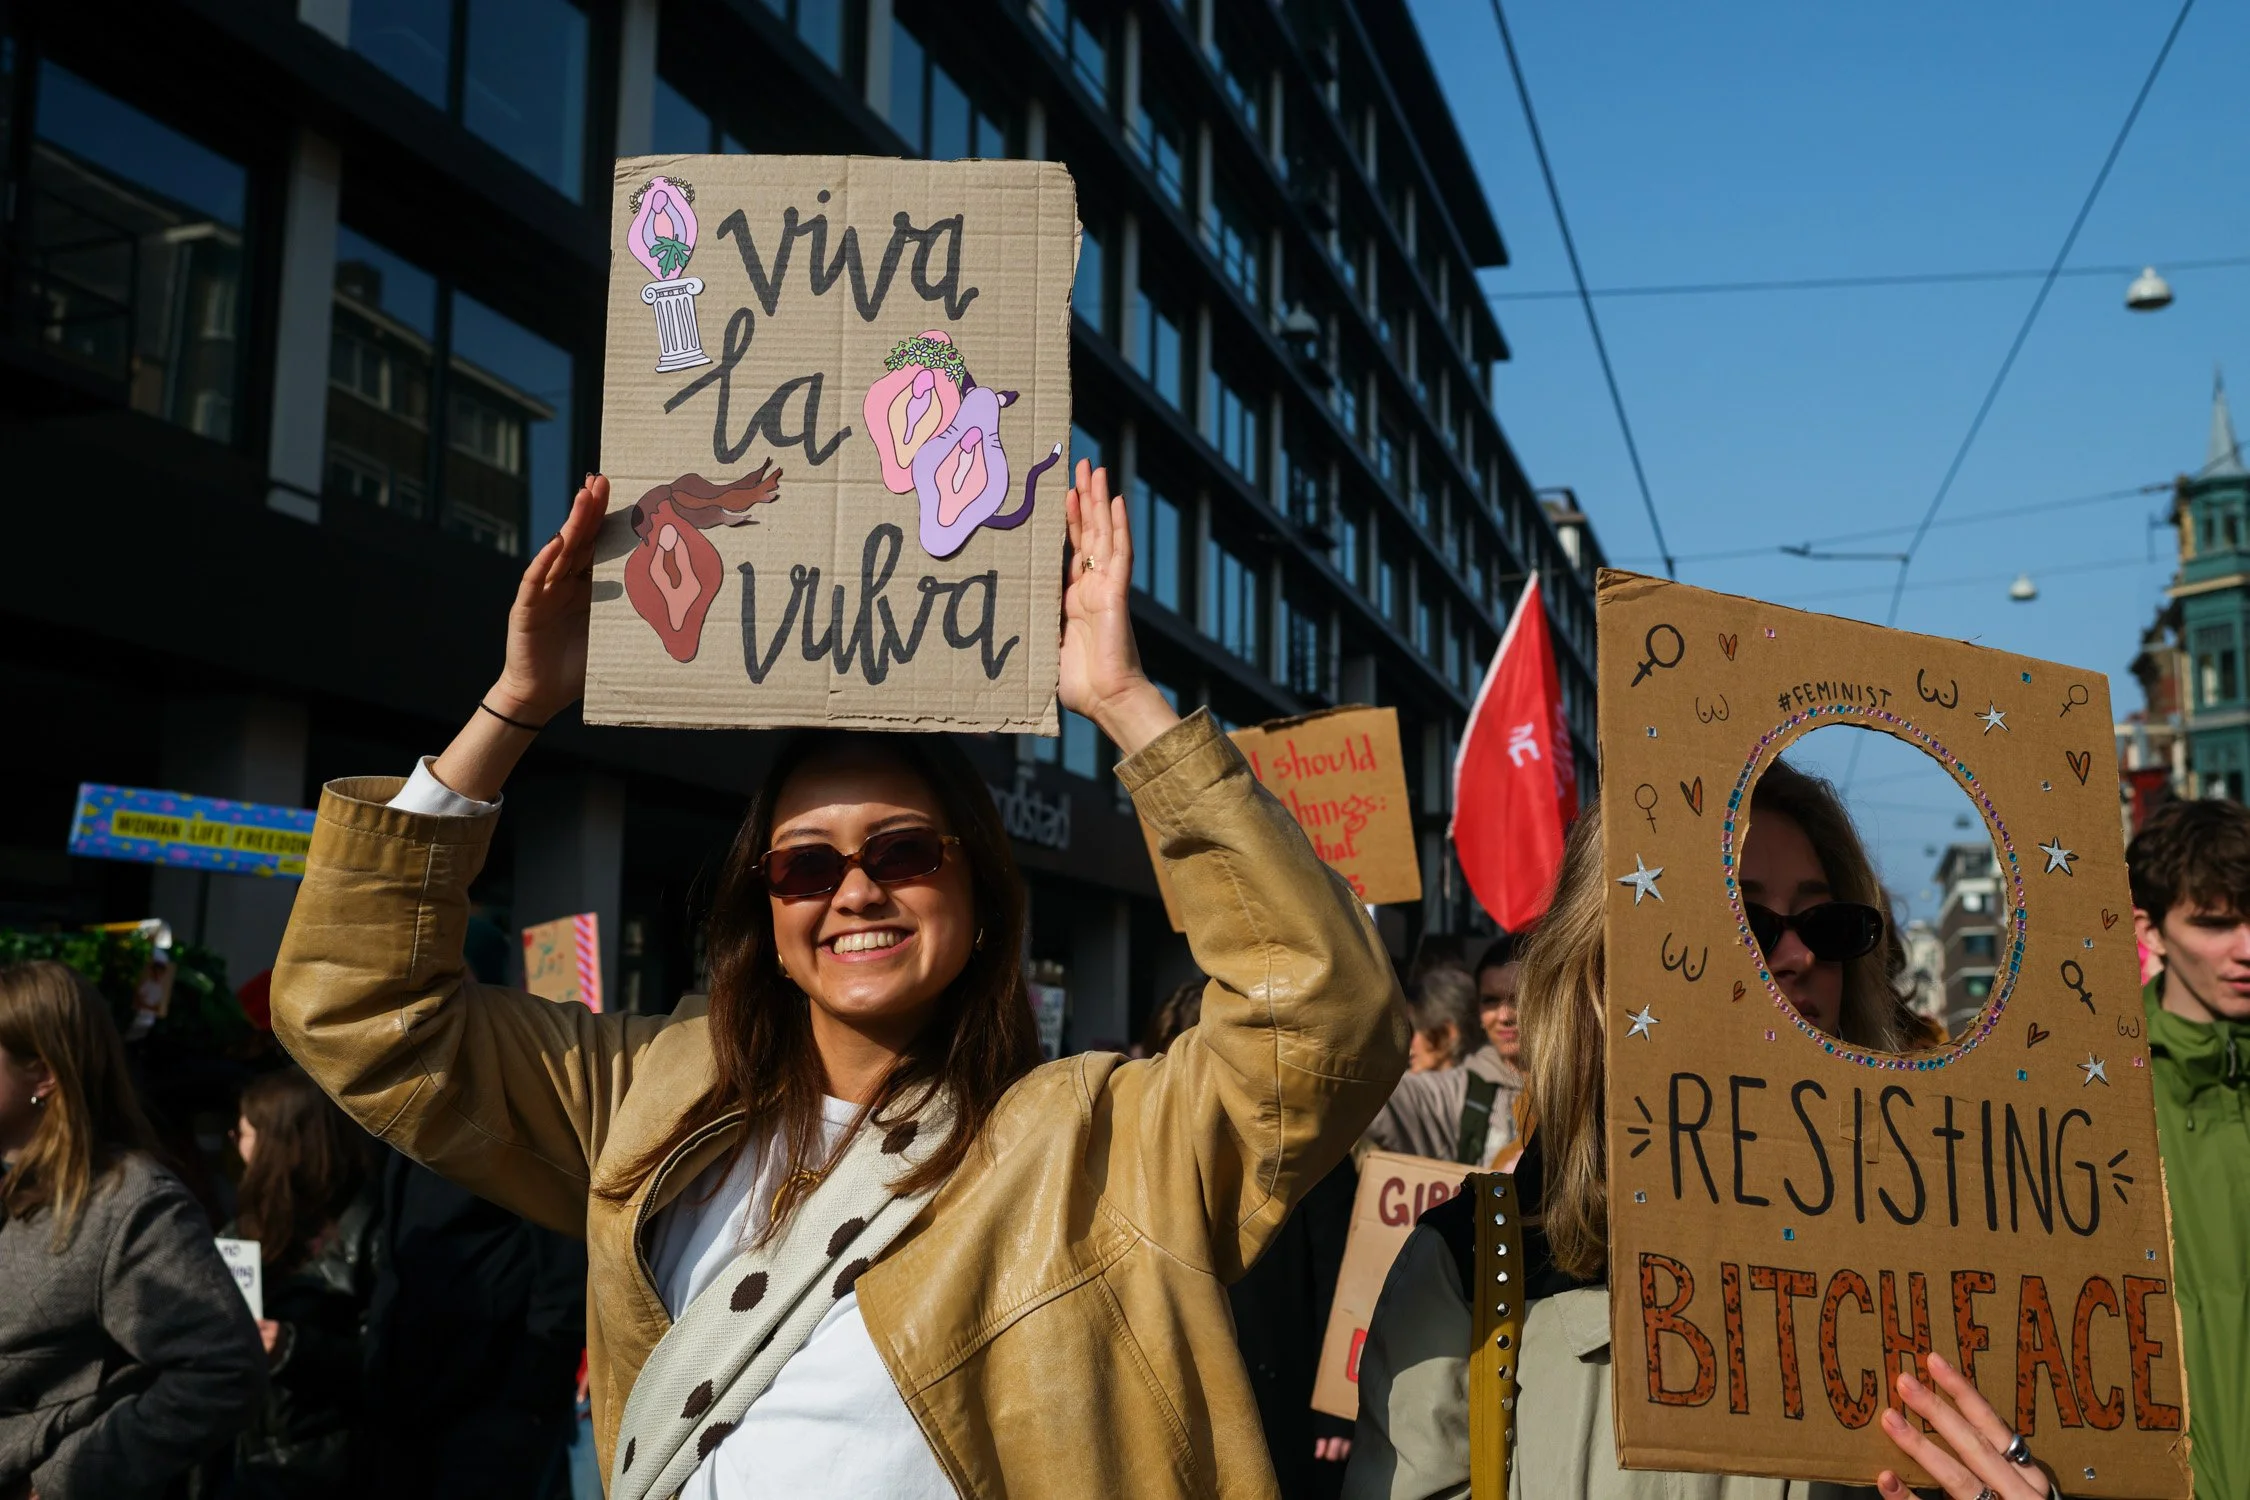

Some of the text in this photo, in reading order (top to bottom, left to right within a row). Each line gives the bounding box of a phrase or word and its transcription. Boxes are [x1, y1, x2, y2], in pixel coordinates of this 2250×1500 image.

[717, 190, 979, 322] viva
[663, 307, 852, 466] la
[1778, 681, 1892, 712] #FEMINIST
[1272, 733, 1377, 781] should
[117, 815, 181, 838] WOMAN
[189, 821, 225, 846] LIFE
[1281, 789, 1387, 834] hings:
[1638, 1252, 2181, 1438] BITCHFACE
